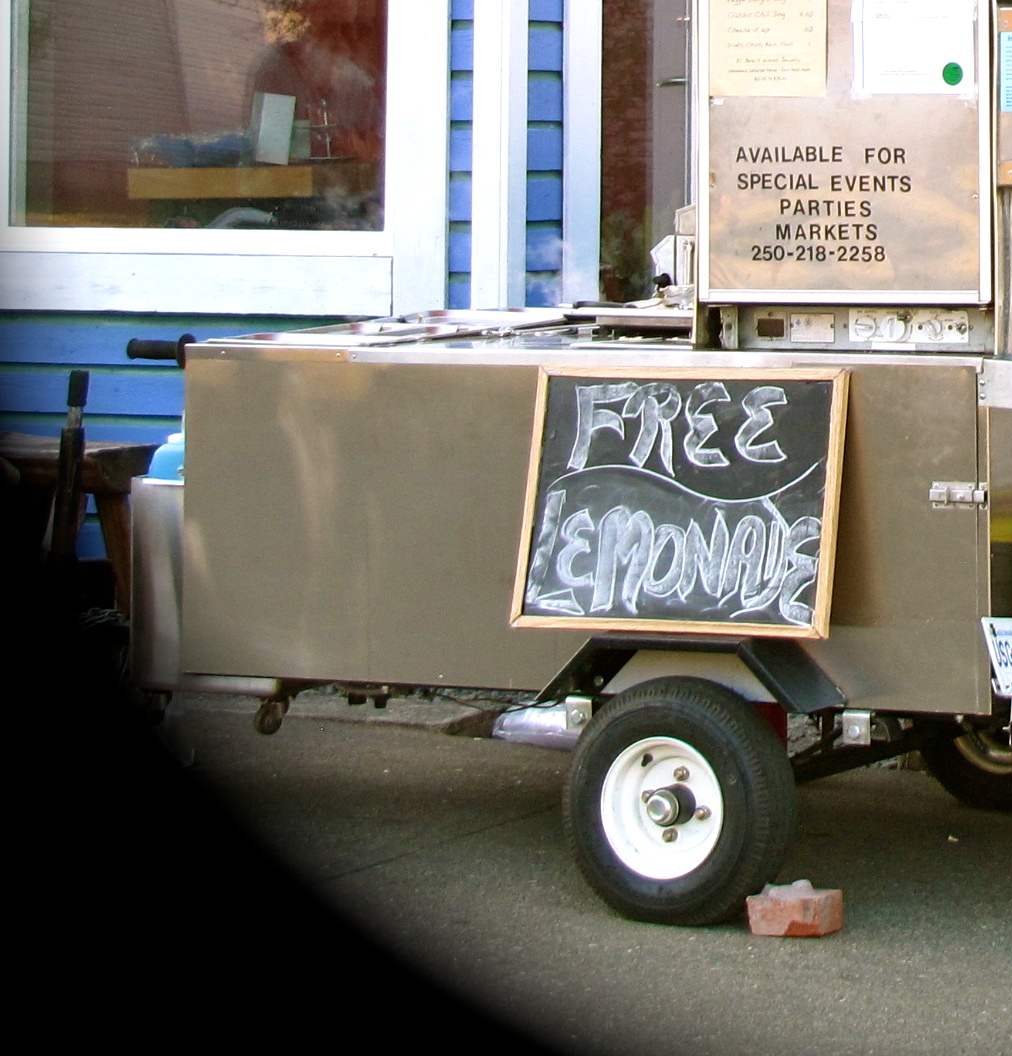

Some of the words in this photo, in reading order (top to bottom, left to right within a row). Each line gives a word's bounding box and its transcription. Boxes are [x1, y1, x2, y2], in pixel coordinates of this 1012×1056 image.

[735, 146, 843, 163] AVAILABLE
[864, 147, 906, 164] FOR
[737, 173, 819, 190] SPECIAL
[830, 175, 912, 192] EVENTS
[779, 199, 872, 217] PARTIES
[775, 224, 878, 241] MARKETS
[751, 246, 886, 262] 250-218-2258
[566, 381, 788, 477] FREE
[525, 490, 822, 628] LEMONADE
